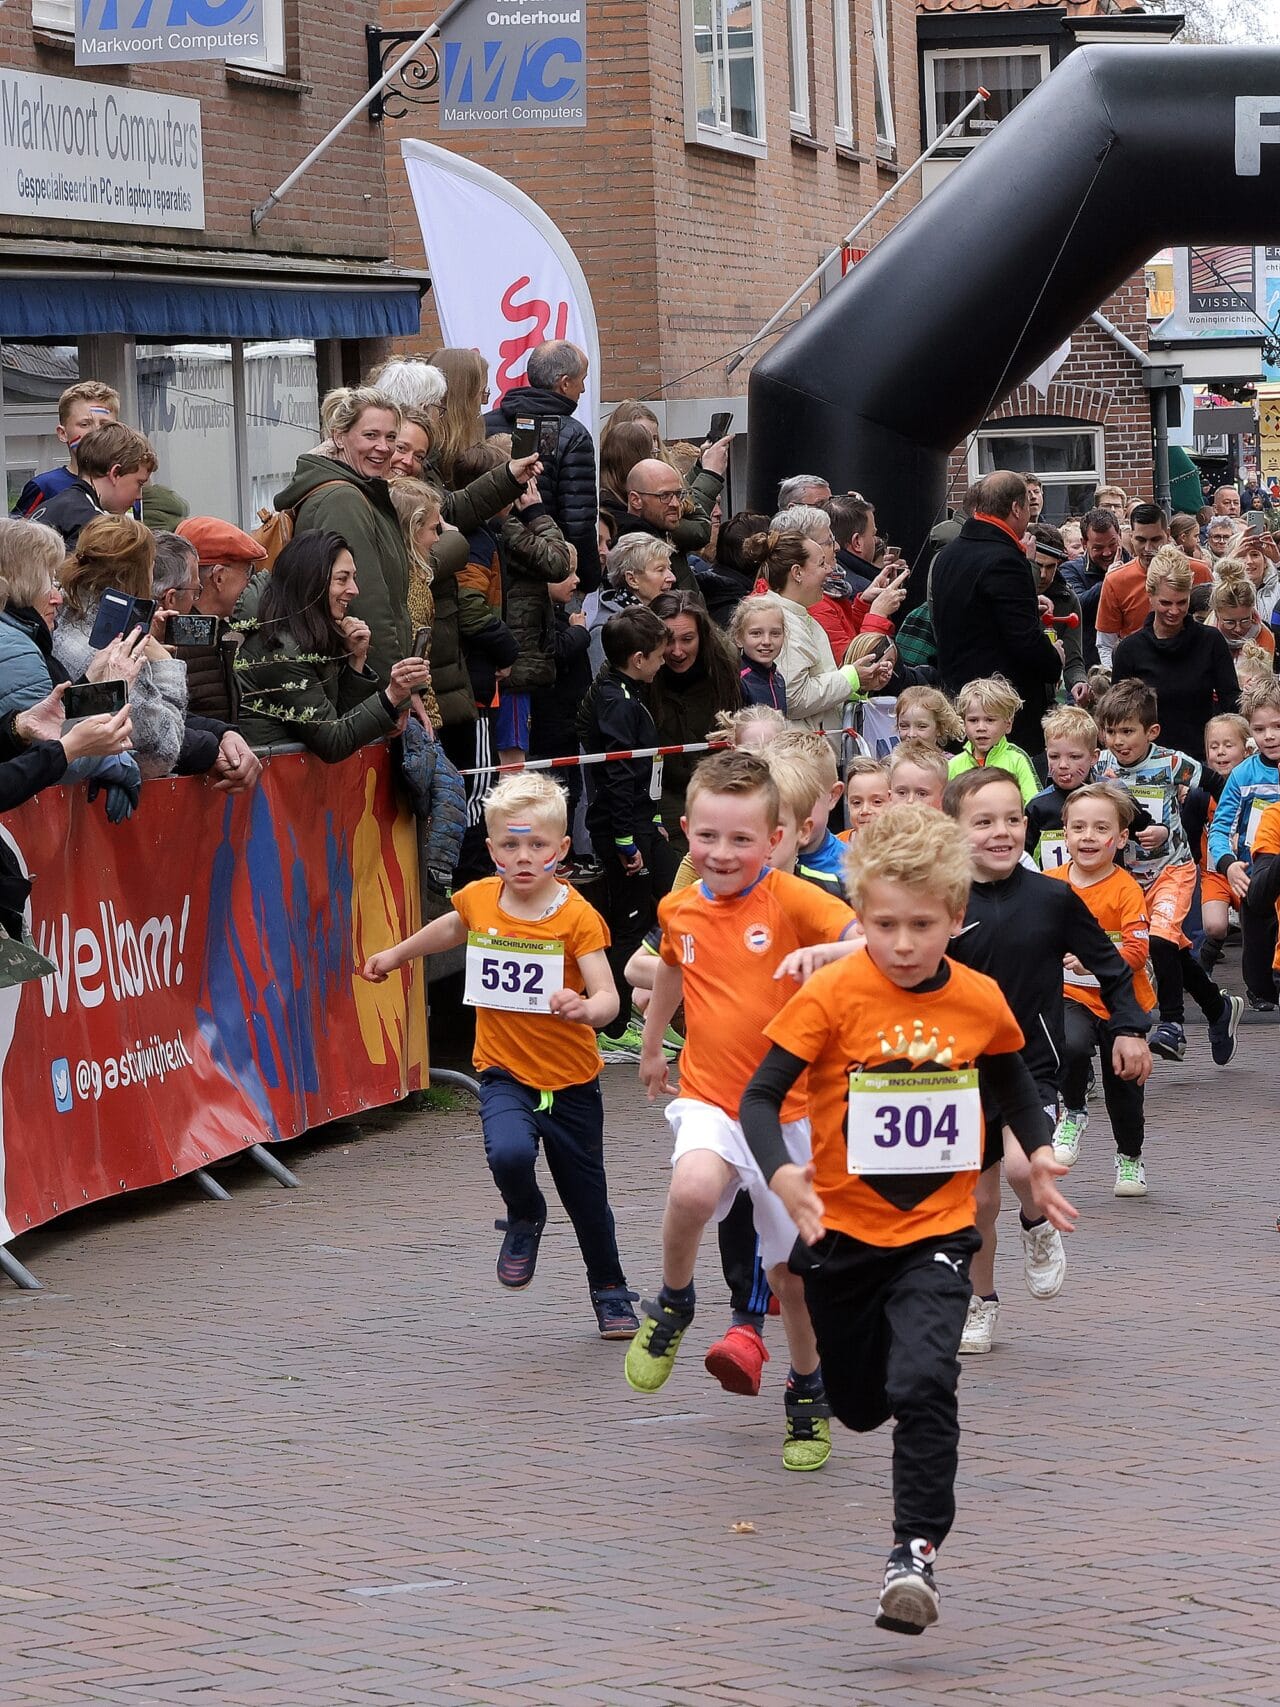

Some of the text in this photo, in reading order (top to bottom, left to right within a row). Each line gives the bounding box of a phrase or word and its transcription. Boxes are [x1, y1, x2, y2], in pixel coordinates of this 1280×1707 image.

[487, 10, 581, 25] Onderhoud
[82, 31, 259, 54] Markvoort Computers
[445, 37, 583, 103] MC
[1, 79, 198, 180] Markvoort Computers
[444, 106, 583, 121] Markvoort Computers
[17, 168, 192, 216] Gespecialiseerd in PC en laptop reparaties
[1188, 316, 1257, 324] Woninginrichting
[1198, 297, 1248, 308] VISSER
[183, 395, 230, 438] Computers
[37, 894, 190, 1018] Welkom!
[476, 937, 554, 951] mijnINSCHRIJVING.nl
[481, 958, 544, 995] 532
[873, 1104, 960, 1148] 304
